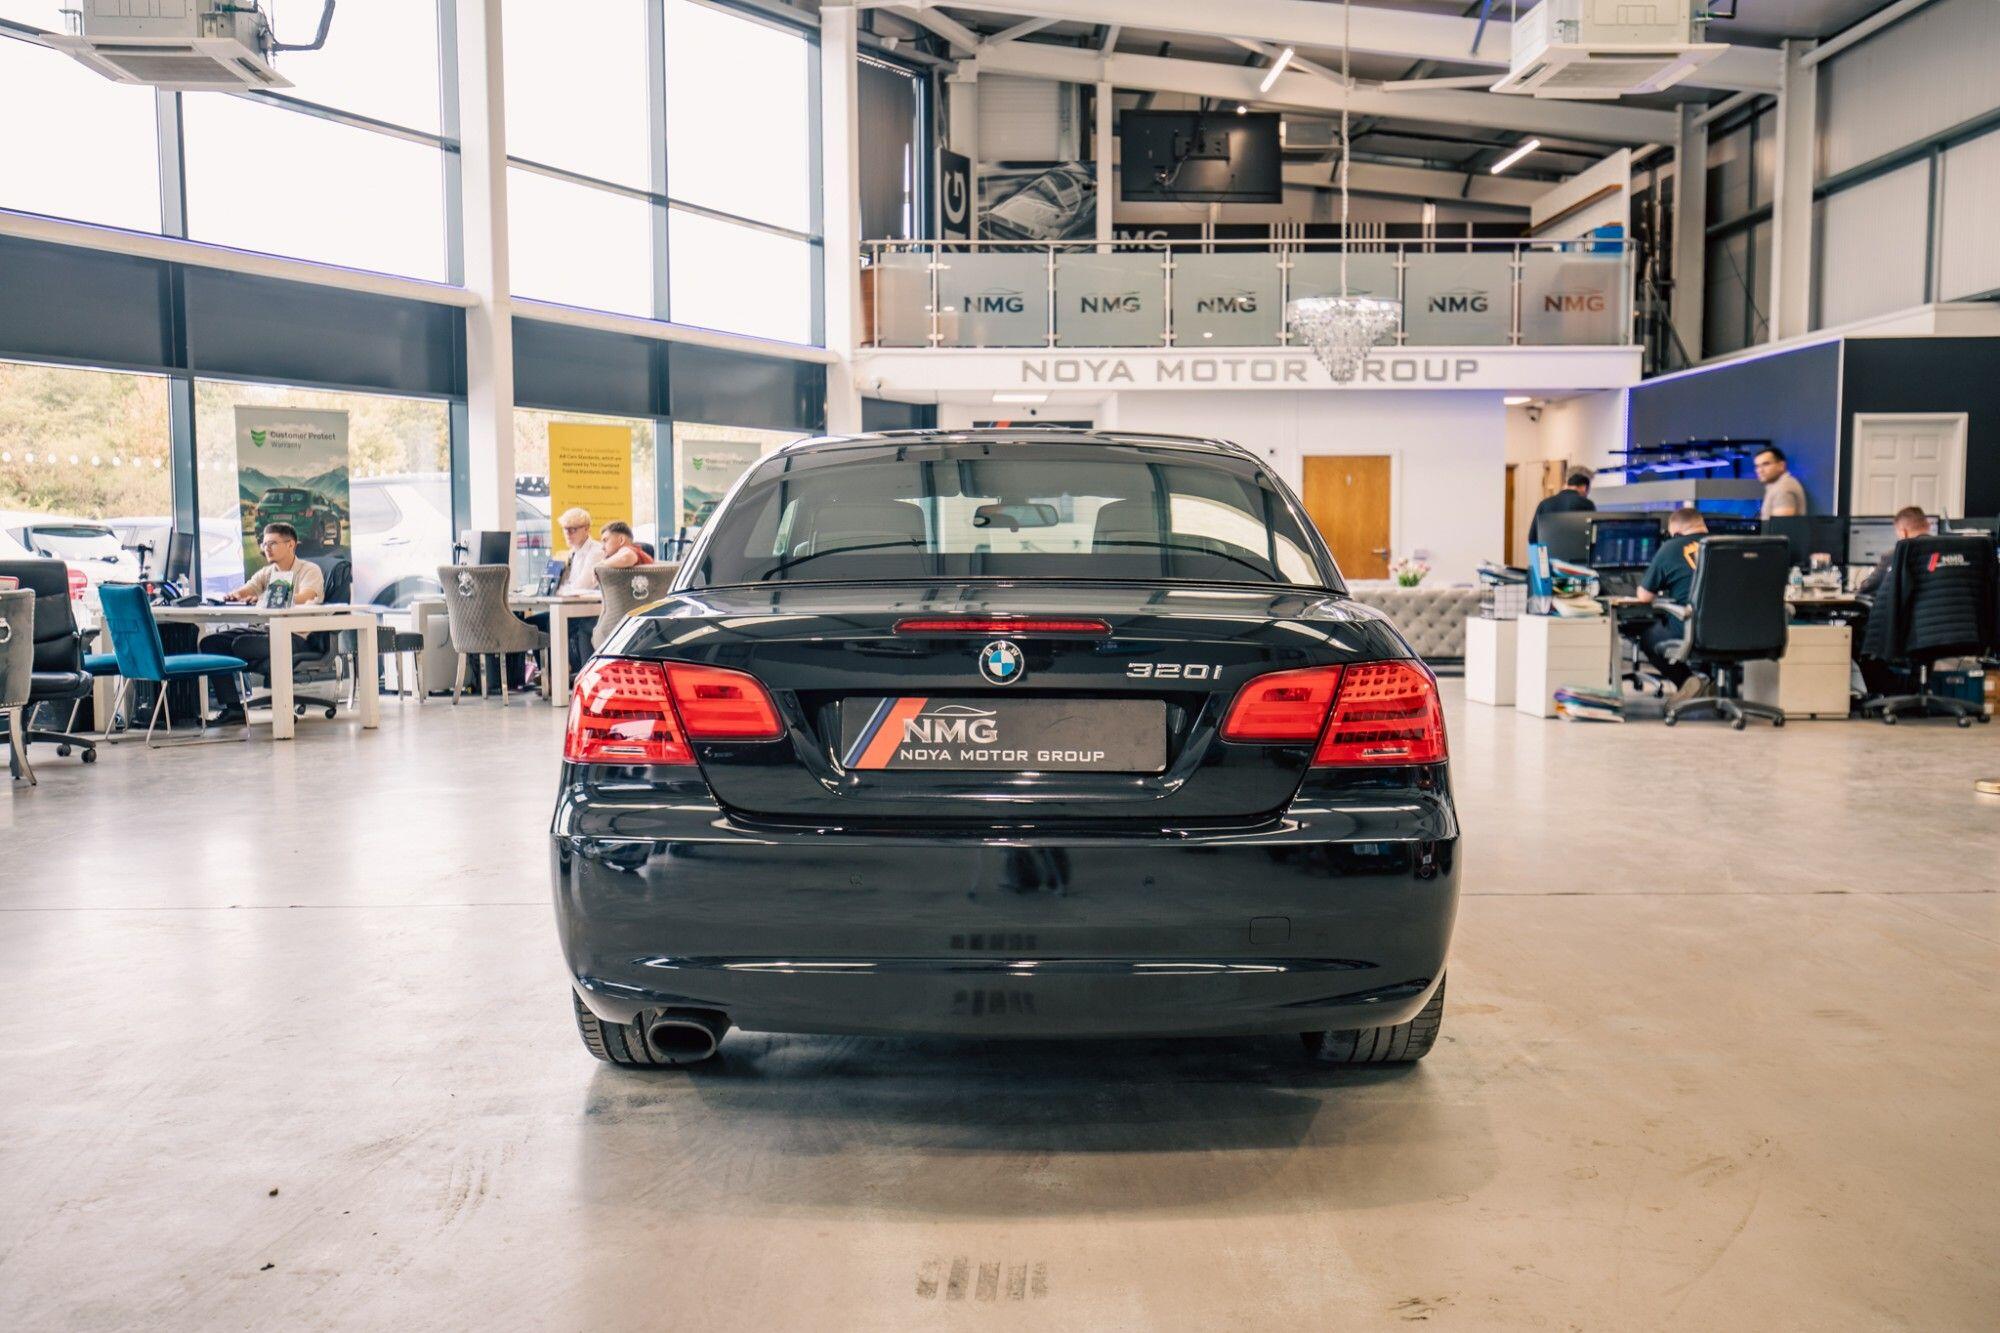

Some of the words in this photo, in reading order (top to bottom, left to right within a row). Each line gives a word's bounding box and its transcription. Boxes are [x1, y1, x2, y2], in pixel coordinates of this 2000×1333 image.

[964, 296, 1024, 313] NMG
[1081, 296, 1140, 313] NMG
[1197, 297, 1257, 313] NMG
[1429, 295, 1488, 313] NMG
[1544, 295, 1605, 312] NMG
[1021, 359, 1135, 382] NOYA
[1156, 359, 1307, 382] MOTOR
[270, 431, 307, 440] Customer
[308, 432, 336, 441] Protect
[985, 641, 1019, 656] BMW
[902, 718, 998, 744] NMG
[901, 749, 952, 761] NOYA
[960, 750, 1029, 761] MOTOR
[1037, 750, 1105, 762] GROUP
